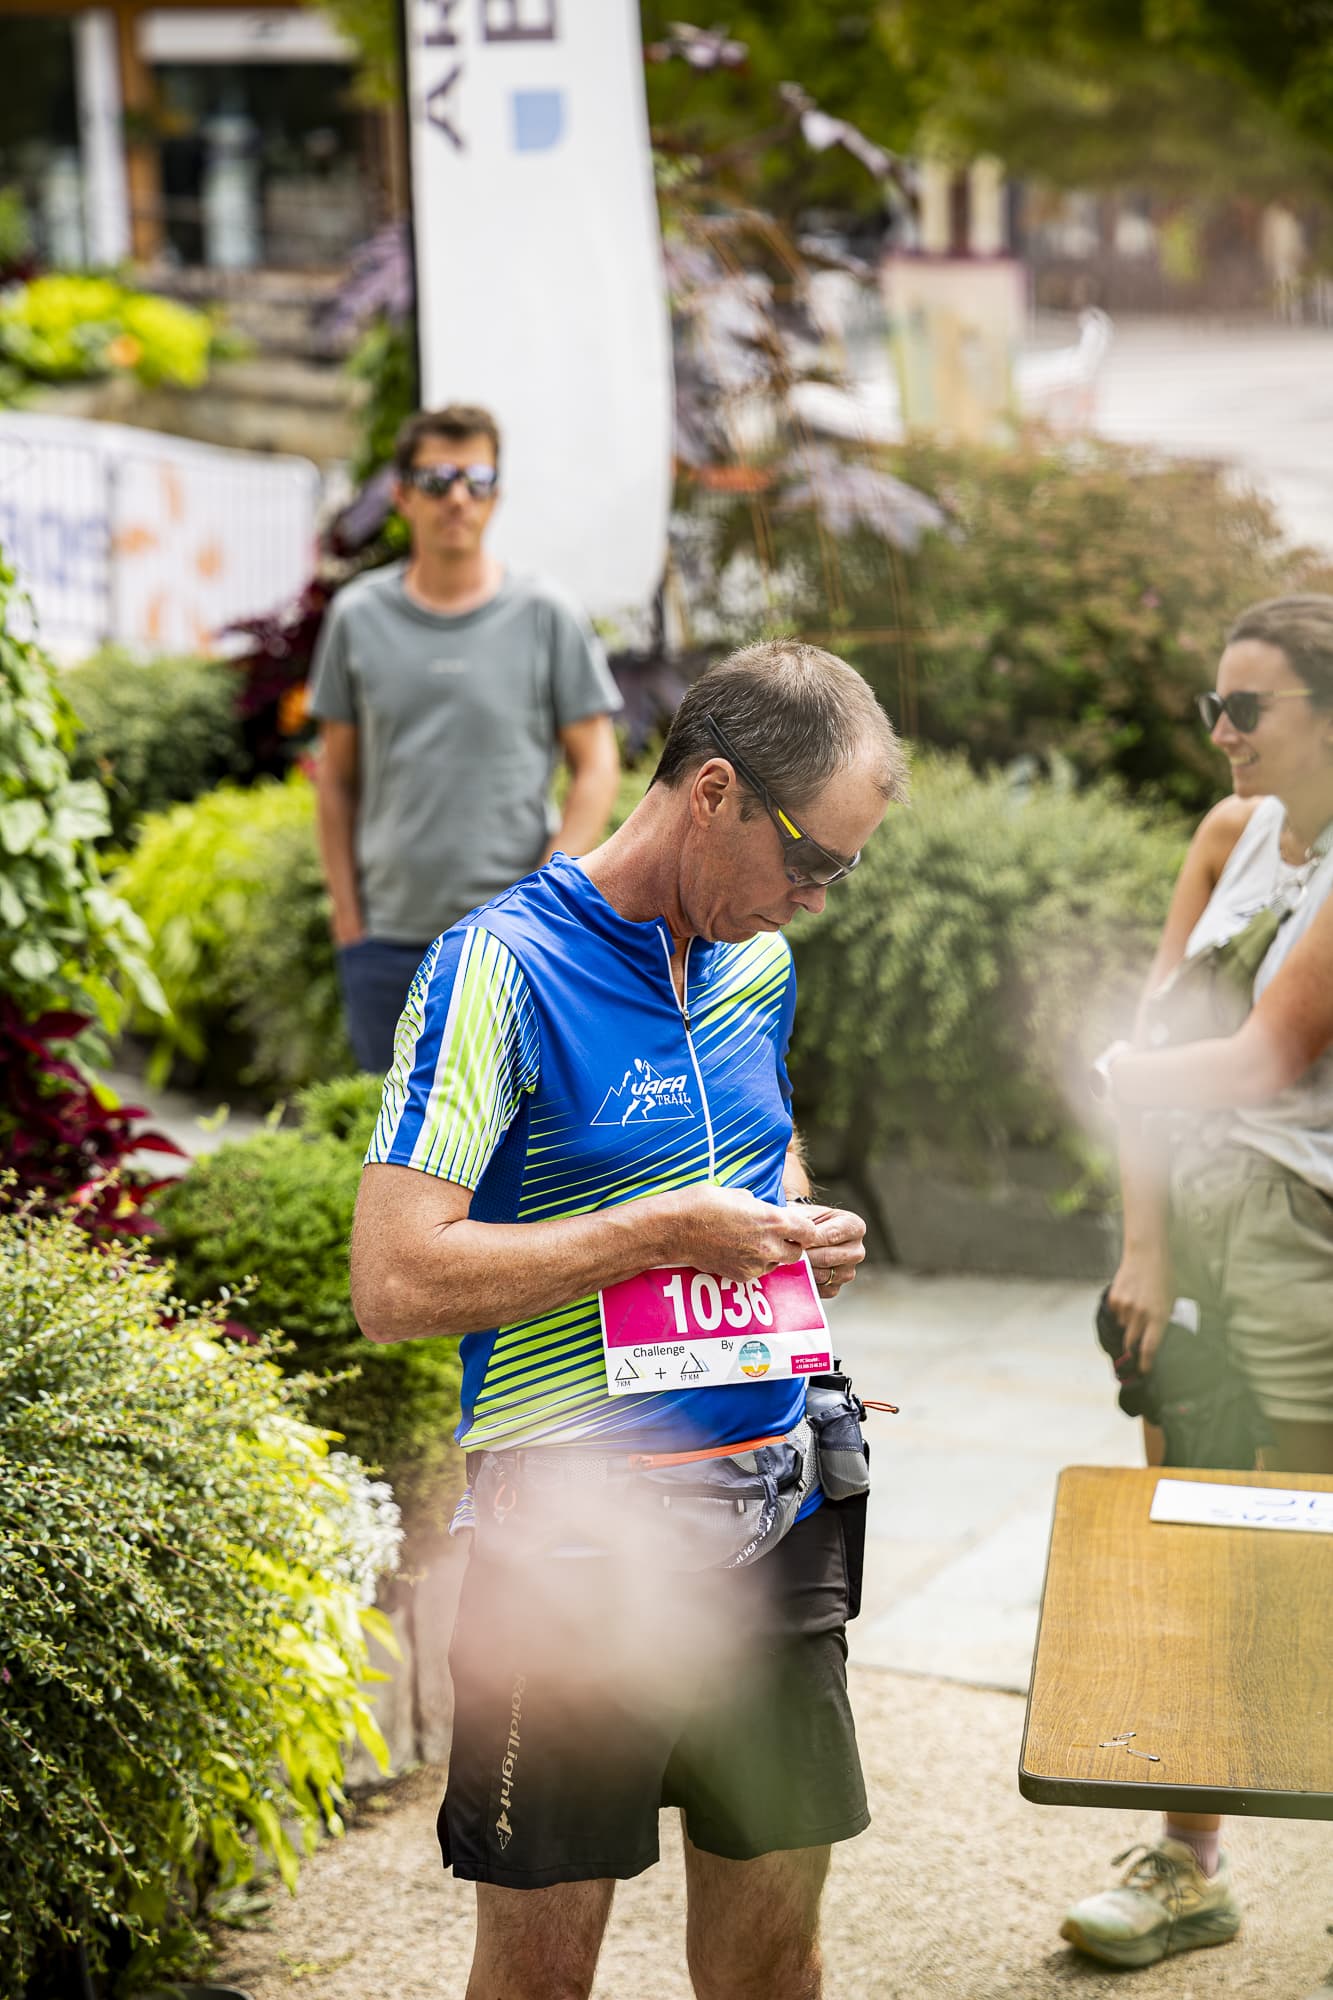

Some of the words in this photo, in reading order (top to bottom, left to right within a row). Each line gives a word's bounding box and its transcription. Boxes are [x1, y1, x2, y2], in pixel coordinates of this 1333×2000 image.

[655, 1091, 692, 1107] TRAIL
[663, 1273, 774, 1334] 1036
[633, 1345, 685, 1358] Challenge
[721, 1339, 734, 1351] By
[500, 1672, 527, 1810] RaidLight
